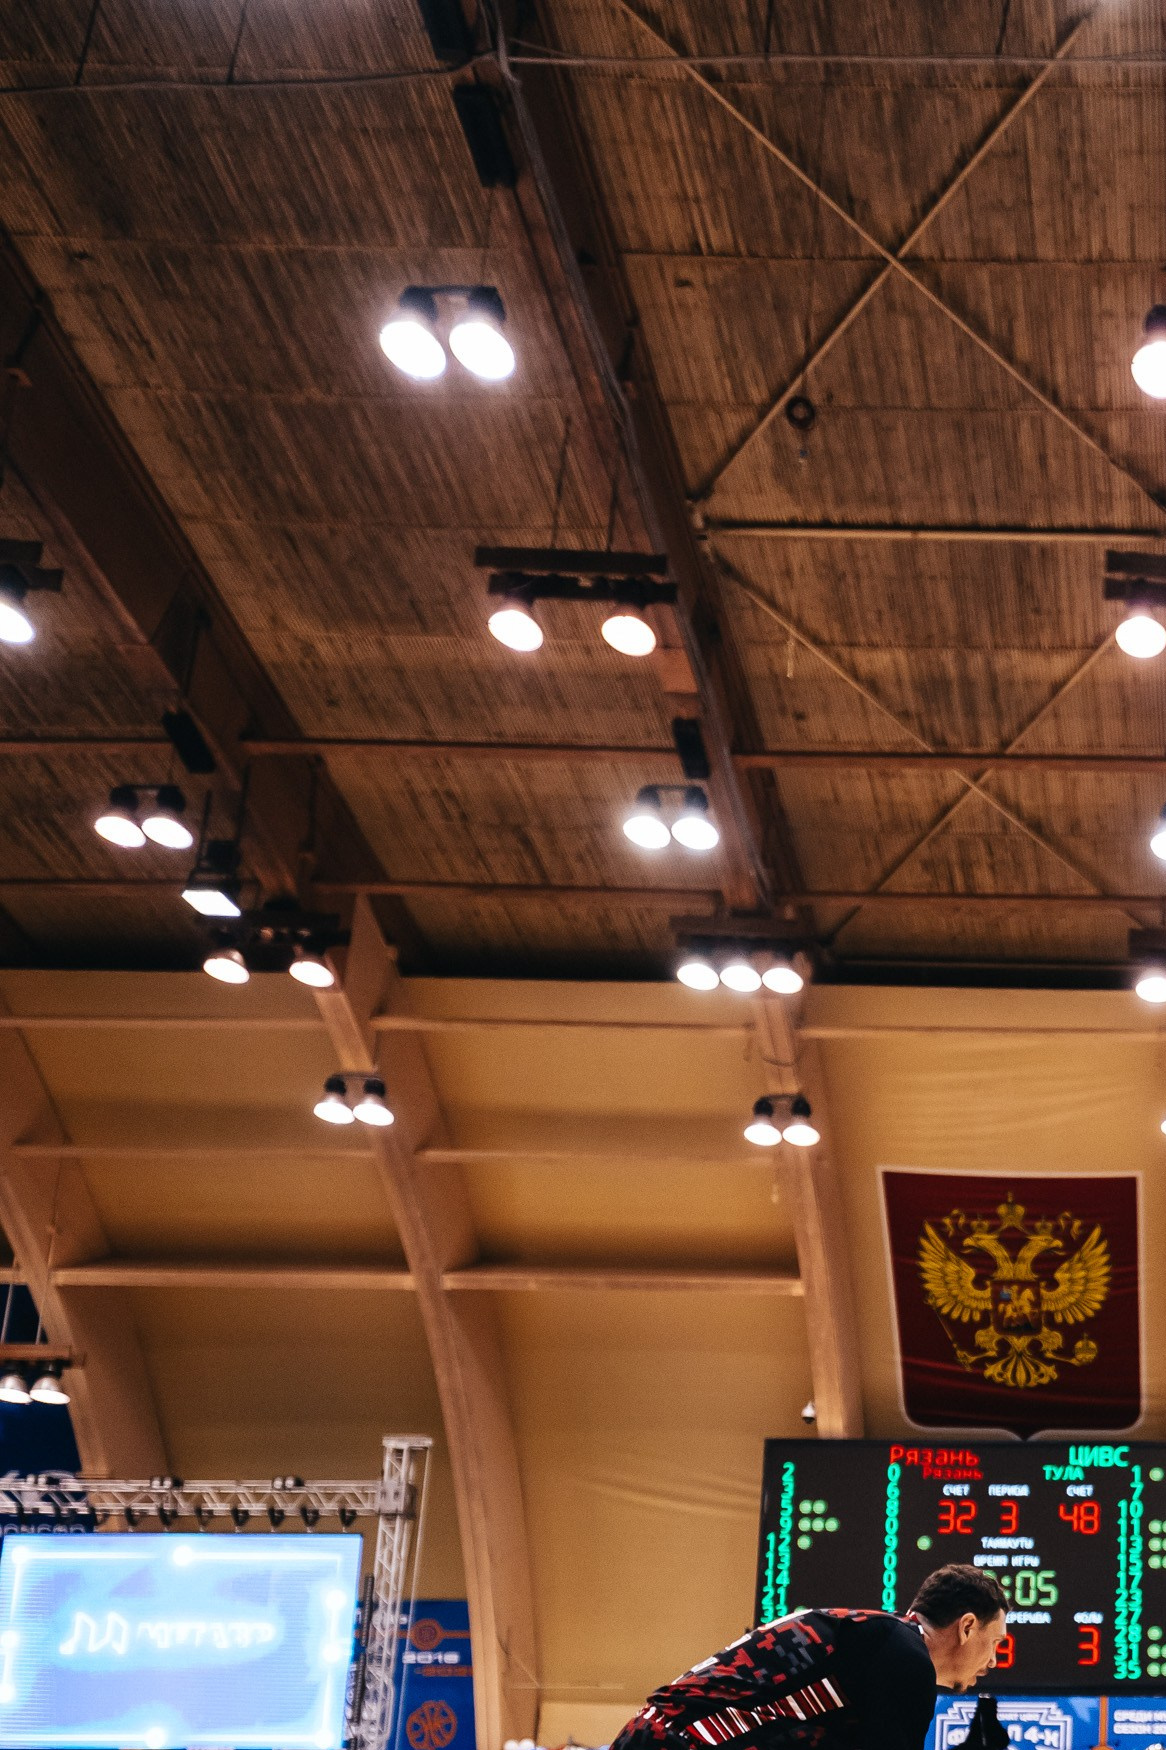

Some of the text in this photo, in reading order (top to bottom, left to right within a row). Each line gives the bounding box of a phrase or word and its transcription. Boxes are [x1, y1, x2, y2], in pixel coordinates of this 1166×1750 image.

[890, 1445, 980, 1467] Рязань
[1069, 1445, 1129, 1467] ЦИВС
[782, 1461, 795, 1482] 2
[887, 1463, 901, 1482] 0
[1043, 1465, 1084, 1481] ТУЛА
[1131, 1465, 1142, 1484] 1
[781, 1481, 794, 1500] 3
[886, 1481, 900, 1500] 6
[1129, 1482, 1144, 1501] 7
[780, 1499, 794, 1517] 5
[885, 1499, 900, 1517] 8
[937, 1500, 977, 1535] 32
[1000, 1500, 1019, 1535] 3
[1058, 1500, 1101, 1535] 48
[1116, 1500, 1144, 1519] 10
[780, 1516, 793, 1534] 9
[885, 1516, 899, 1535] 0
[1116, 1517, 1141, 1536] 11
[766, 1532, 791, 1552] 12
[884, 1534, 898, 1552] 9
[1116, 1535, 1143, 1554] 13
[765, 1550, 791, 1570] 13
[883, 1551, 897, 1570] 0
[1116, 1553, 1143, 1572] 15
[764, 1568, 790, 1587] 14
[882, 1569, 897, 1588] 0
[1116, 1570, 1143, 1589] 17
[761, 1585, 787, 1605] 21
[881, 1587, 896, 1606] 0
[1115, 1588, 1142, 1607] 23
[1114, 1606, 1142, 1625] 27
[1114, 1623, 1142, 1642] 28
[1078, 1625, 1101, 1666] 3
[1113, 1641, 1141, 1660] 31
[1113, 1660, 1141, 1679] 35
